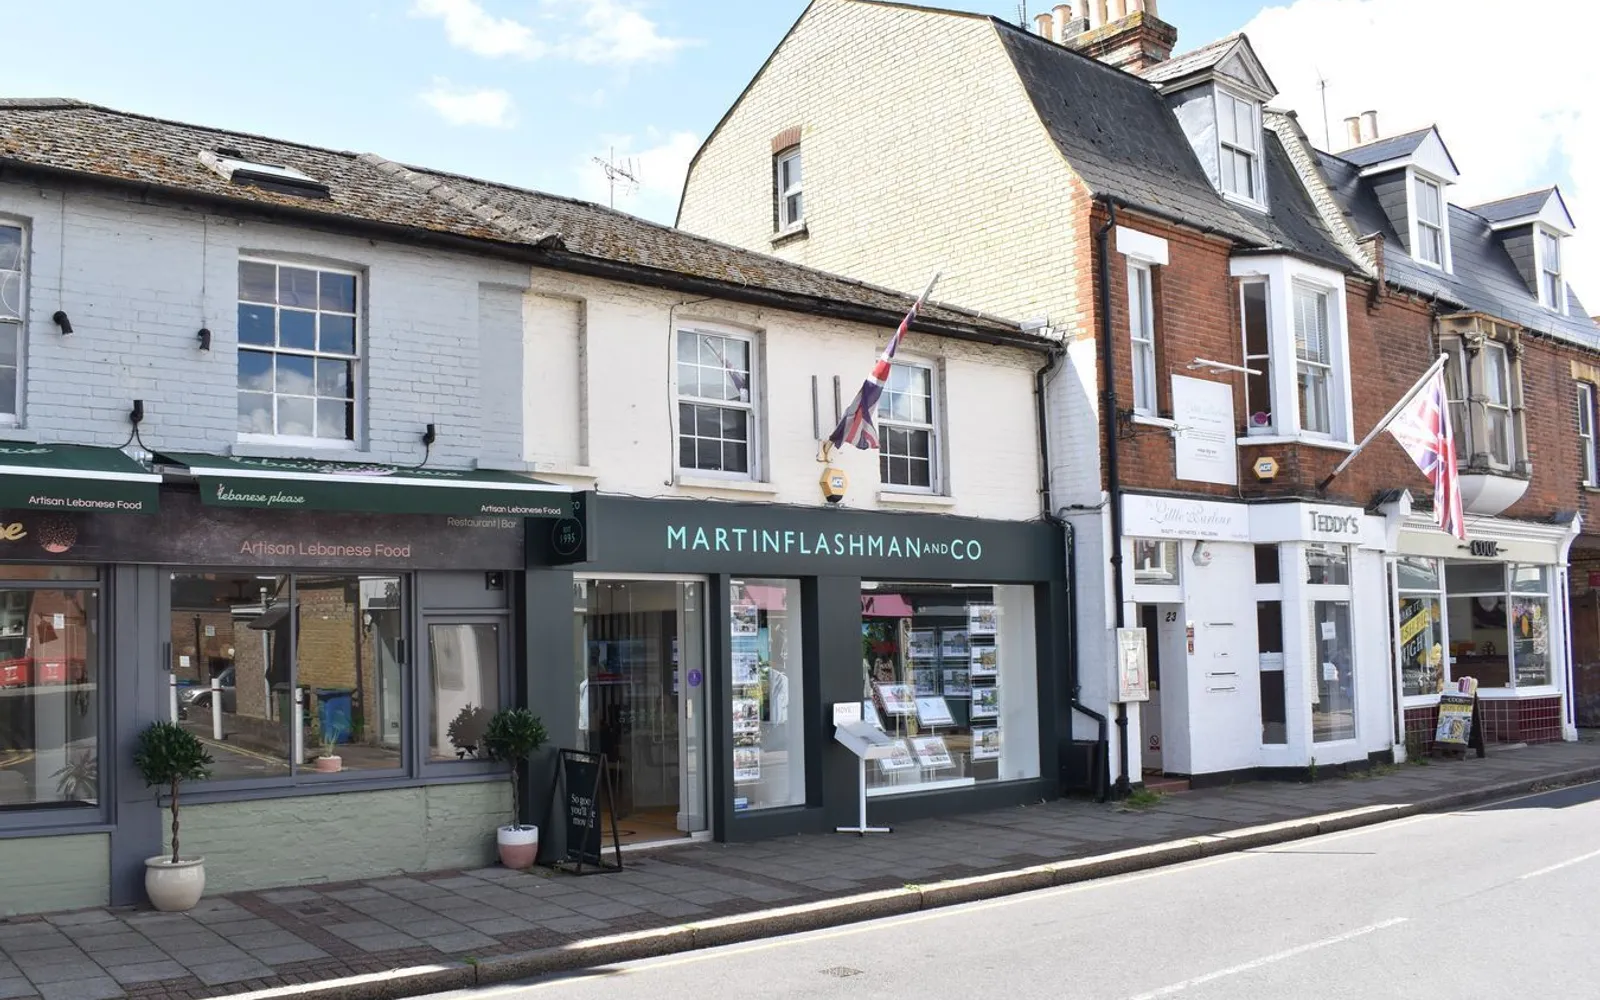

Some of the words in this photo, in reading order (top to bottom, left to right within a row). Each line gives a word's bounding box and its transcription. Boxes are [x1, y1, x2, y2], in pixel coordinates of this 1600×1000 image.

[28, 495, 65, 506] Artisan
[66, 498, 115, 509] Lebanese
[117, 500, 142, 510] Food
[267, 494, 306, 505] please
[481, 504, 507, 513] Artisan
[508, 506, 543, 514] Lebanese
[543, 507, 562, 515] Food
[447, 517, 496, 528] Restaurant
[501, 519, 517, 529] Bar
[1309, 511, 1359, 534] TEDDY'S
[559, 533, 576, 544] 1995
[240, 541, 295, 555] Artisan
[299, 542, 372, 557] Lebanese
[375, 543, 411, 558] Food
[1474, 540, 1498, 556] COOK
[1166, 611, 1177, 622] 23
[571, 793, 580, 804] So
[580, 797, 592, 806] goo
[573, 817, 594, 828] movd
